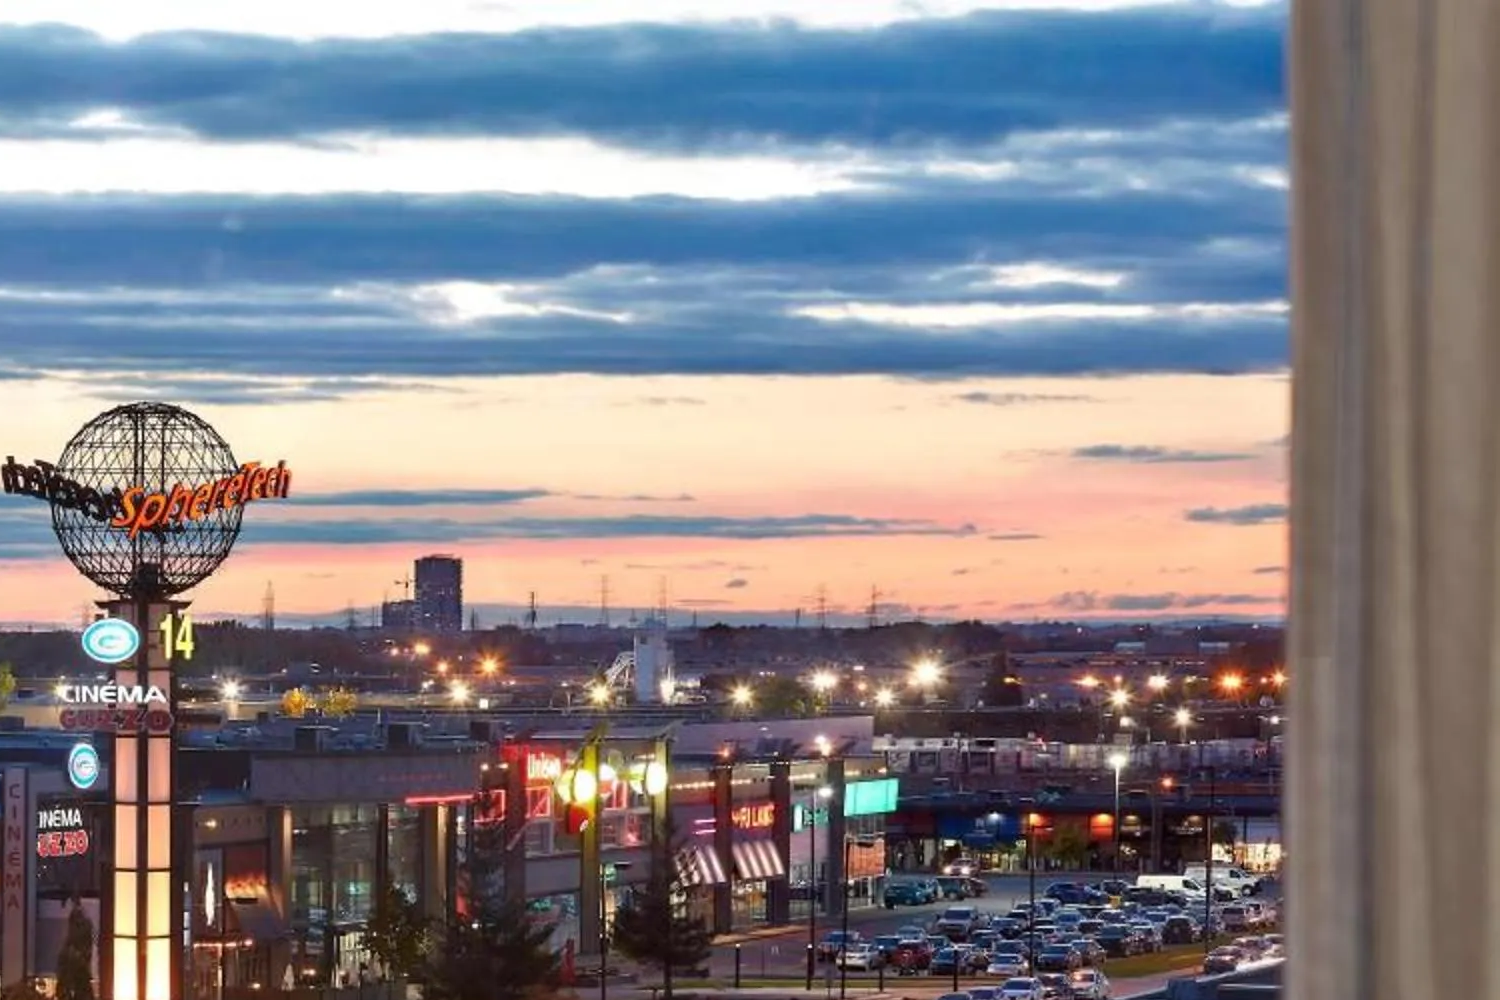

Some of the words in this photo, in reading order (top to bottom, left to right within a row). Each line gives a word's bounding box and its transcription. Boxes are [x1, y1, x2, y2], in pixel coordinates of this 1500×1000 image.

[111, 460, 291, 541] SphereTech
[160, 613, 195, 660] 14
[58, 680, 167, 704] CINÉMA
[37, 804, 83, 829] INÉMA
